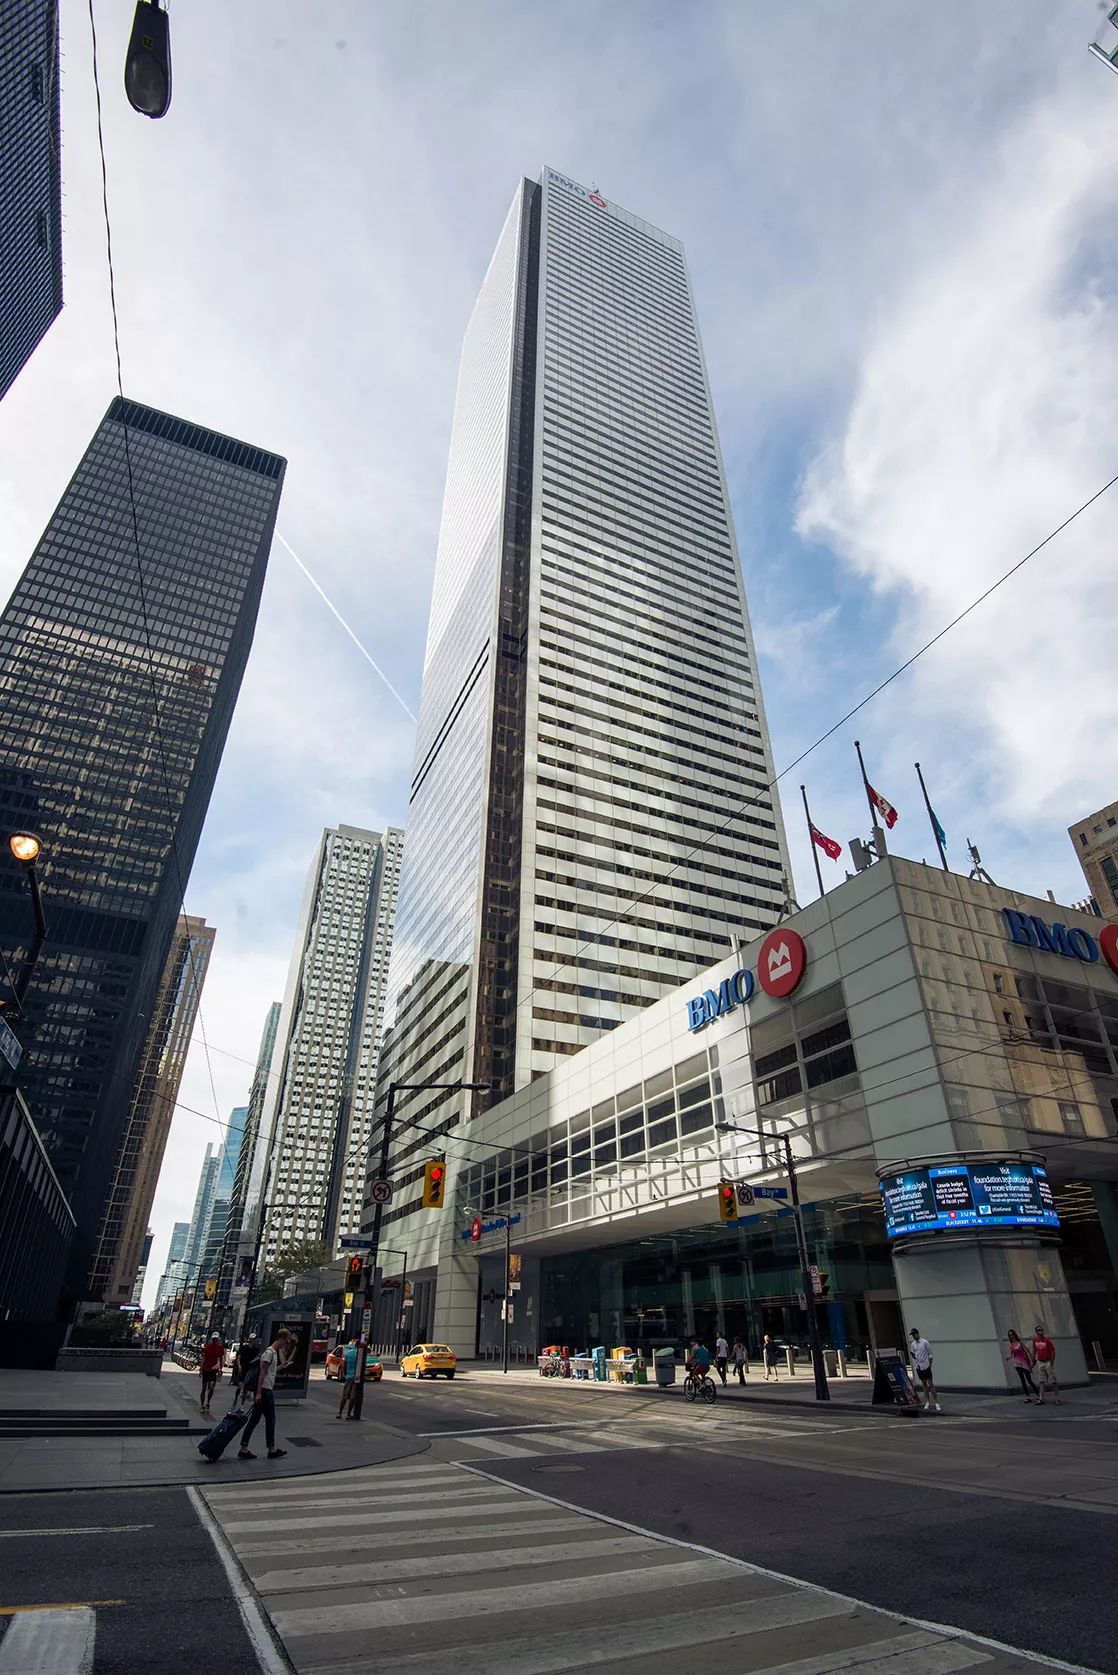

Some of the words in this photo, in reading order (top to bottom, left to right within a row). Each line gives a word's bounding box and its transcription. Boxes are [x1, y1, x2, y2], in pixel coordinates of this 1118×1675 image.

[549, 172, 586, 197] BMO
[1002, 907, 1099, 963] BMO
[686, 967, 755, 1032] BMO
[762, 1188, 774, 1198] Bay
